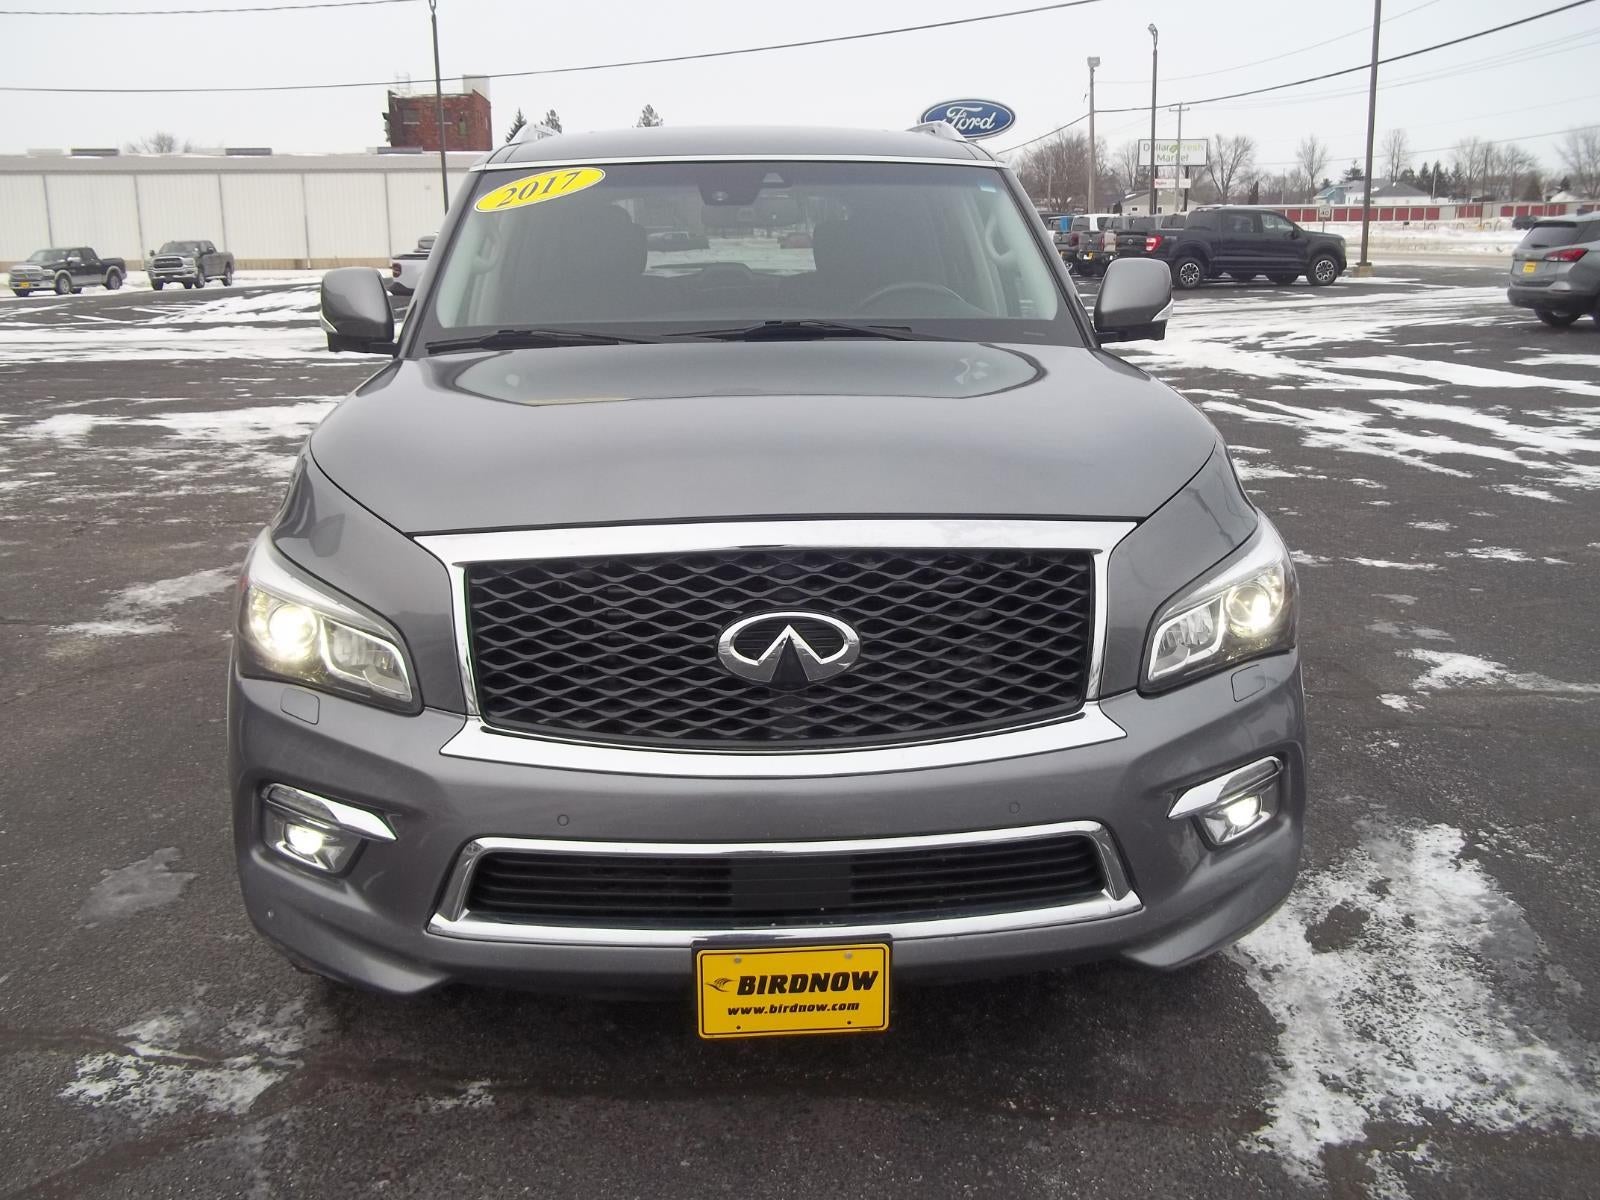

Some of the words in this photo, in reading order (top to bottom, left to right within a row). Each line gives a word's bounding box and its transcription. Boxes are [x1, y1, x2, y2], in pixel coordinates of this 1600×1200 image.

[945, 106, 996, 130] Ford
[1143, 142, 1170, 152] Dllar
[496, 170, 582, 207] 2017
[736, 970, 879, 996] BIRDNOW
[727, 1002, 860, 1016] www.birdnow.com
